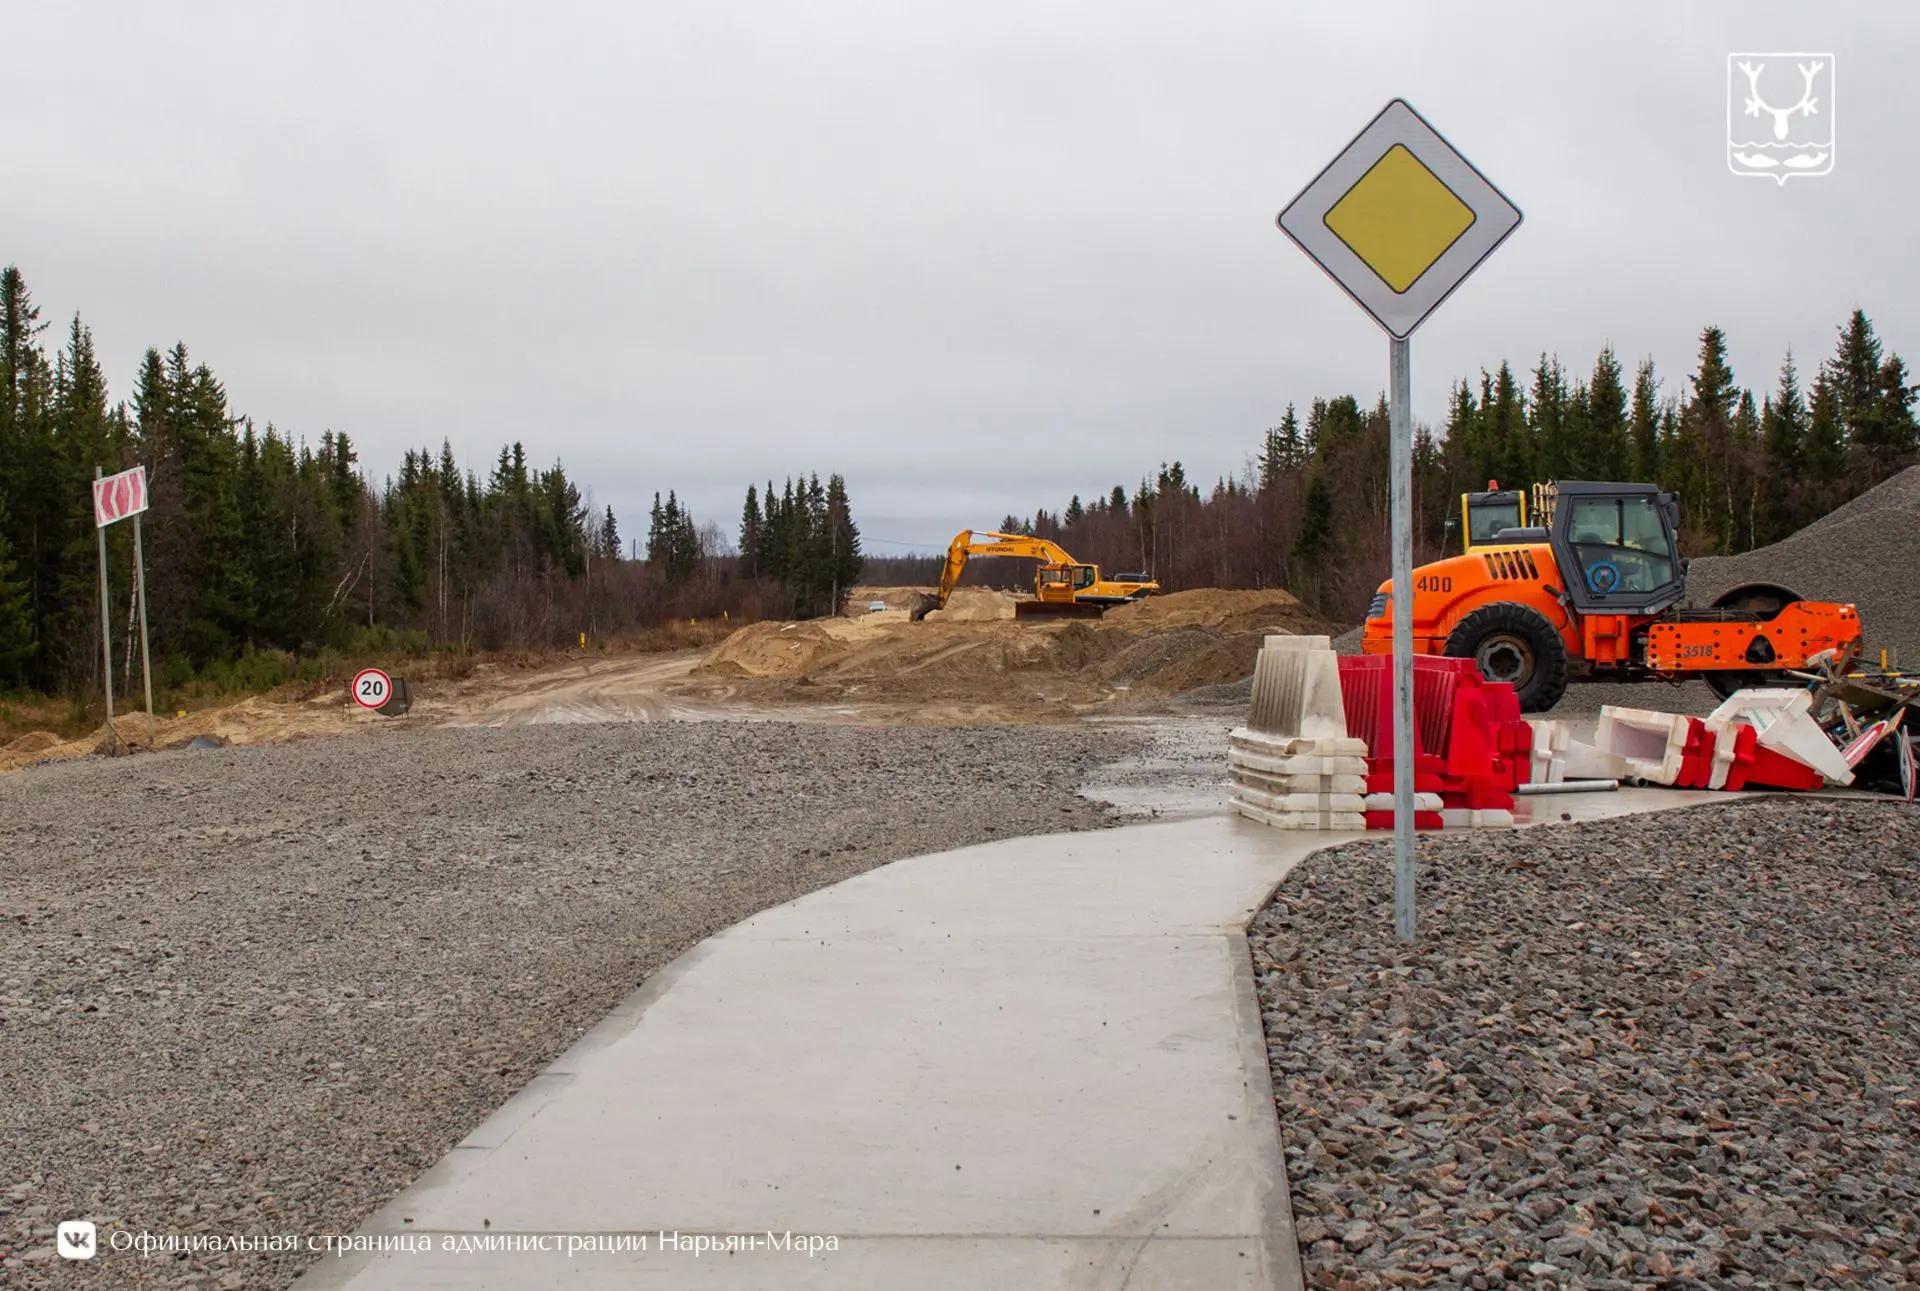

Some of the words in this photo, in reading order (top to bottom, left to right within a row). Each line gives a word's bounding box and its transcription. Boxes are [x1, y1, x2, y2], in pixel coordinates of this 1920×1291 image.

[1417, 576, 1452, 593] 400
[1683, 645, 1713, 658] 3518
[361, 680, 383, 696] 20
